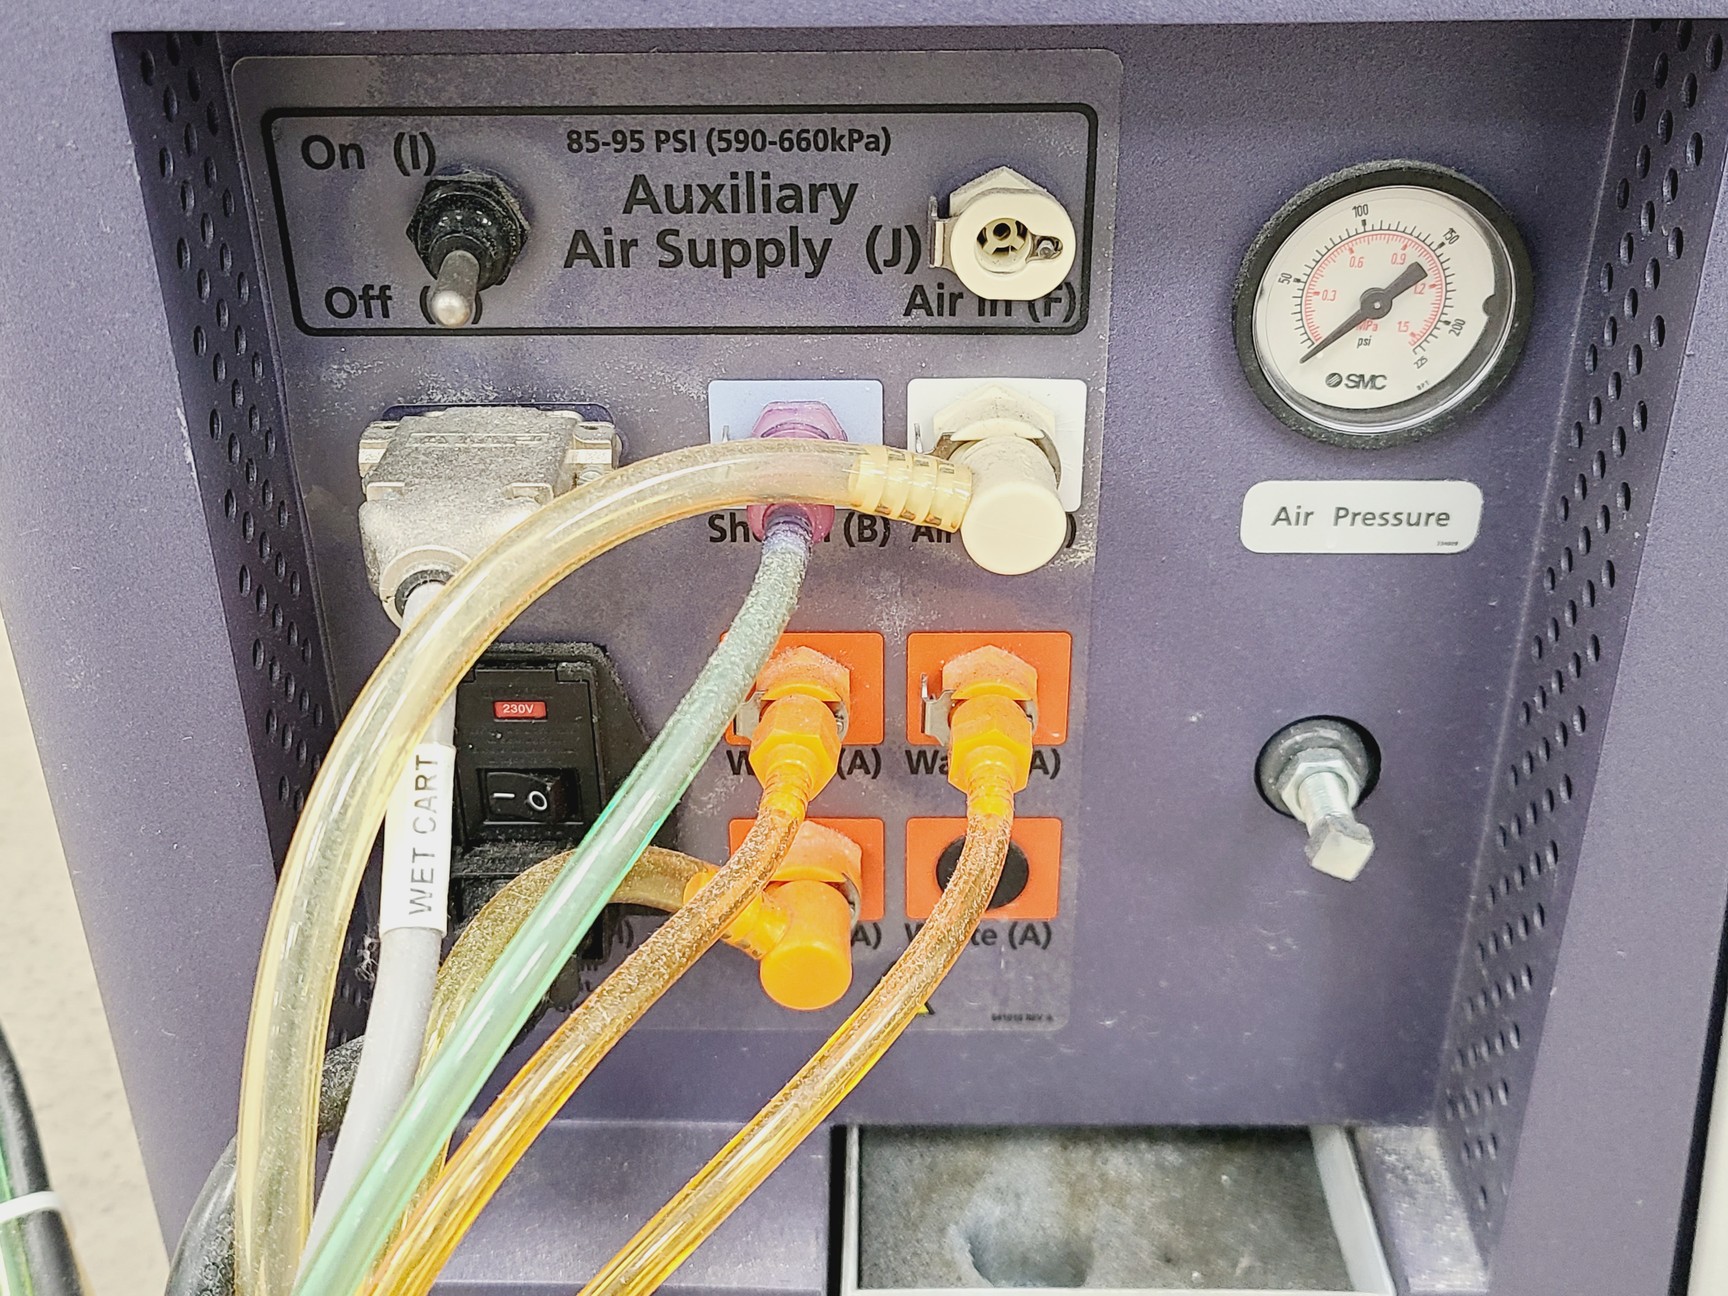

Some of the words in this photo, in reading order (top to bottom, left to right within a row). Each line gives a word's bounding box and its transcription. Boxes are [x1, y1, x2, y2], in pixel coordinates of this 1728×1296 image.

[301, 134, 366, 170] On
[566, 128, 645, 154] 85-95
[655, 129, 697, 154] PSI
[706, 126, 891, 157] (590-660kPa)
[622, 171, 859, 225] Auxiliary
[1352, 203, 1369, 218] 100
[564, 227, 638, 268] Air
[656, 225, 833, 278] Supply
[866, 224, 922, 275] (J)
[1443, 227, 1460, 246] 150
[1349, 256, 1365, 269] 0.6
[1390, 252, 1407, 265] 0.9
[1278, 272, 1293, 286] 50
[324, 284, 393, 319] Off
[903, 282, 964, 317] Air
[1322, 290, 1337, 302] 0.3
[1356, 320, 1379, 332] MPa
[1449, 318, 1467, 338] 200
[1356, 335, 1373, 349] psi
[1344, 373, 1388, 391] SMC
[843, 512, 891, 548] (B)
[1271, 505, 1315, 527] Air
[1333, 505, 1452, 527] Pressure
[502, 703, 535, 715] 230V
[837, 747, 882, 780] (A)
[1031, 747, 1061, 780] A)
[412, 754, 439, 835] CART
[409, 847, 436, 916] WET
[851, 920, 882, 951] A)
[1007, 920, 1053, 951] (A)
